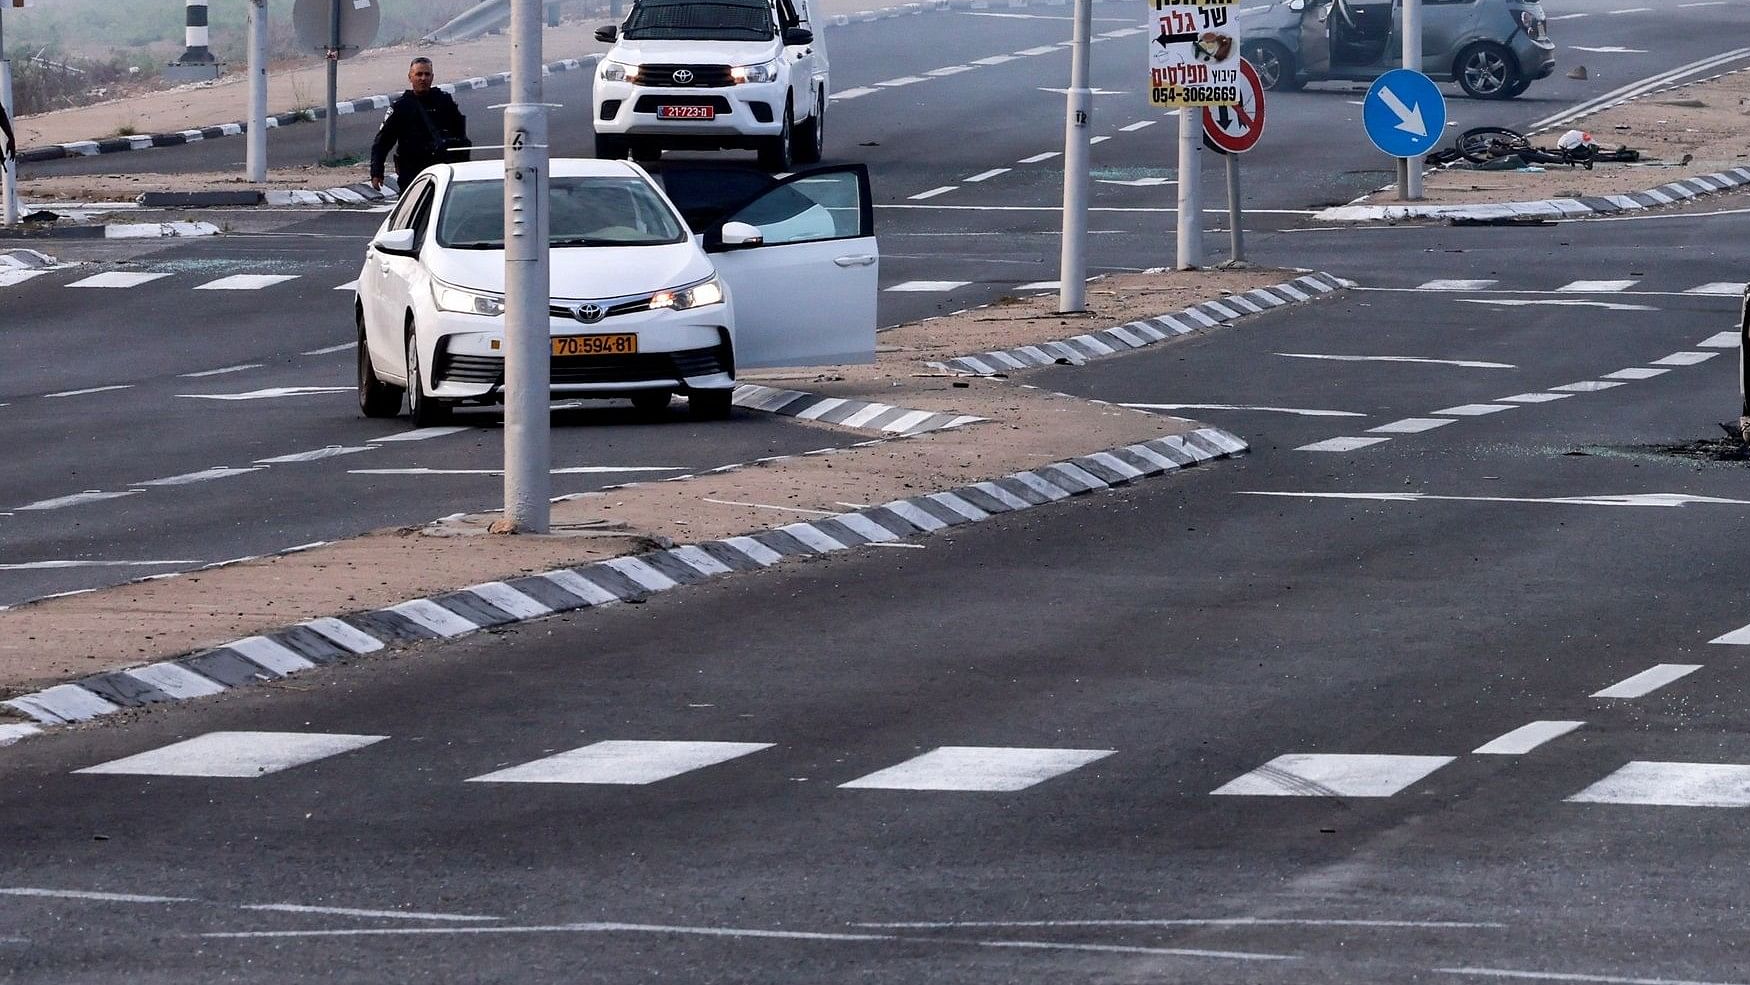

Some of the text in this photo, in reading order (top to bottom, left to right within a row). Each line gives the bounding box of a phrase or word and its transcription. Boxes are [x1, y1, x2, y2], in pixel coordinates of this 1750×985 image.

[1159, 6, 1227, 35] של גלה
[1151, 62, 1237, 87] קיבוץ מפלסים
[1152, 87, 1237, 103] 054-3062669
